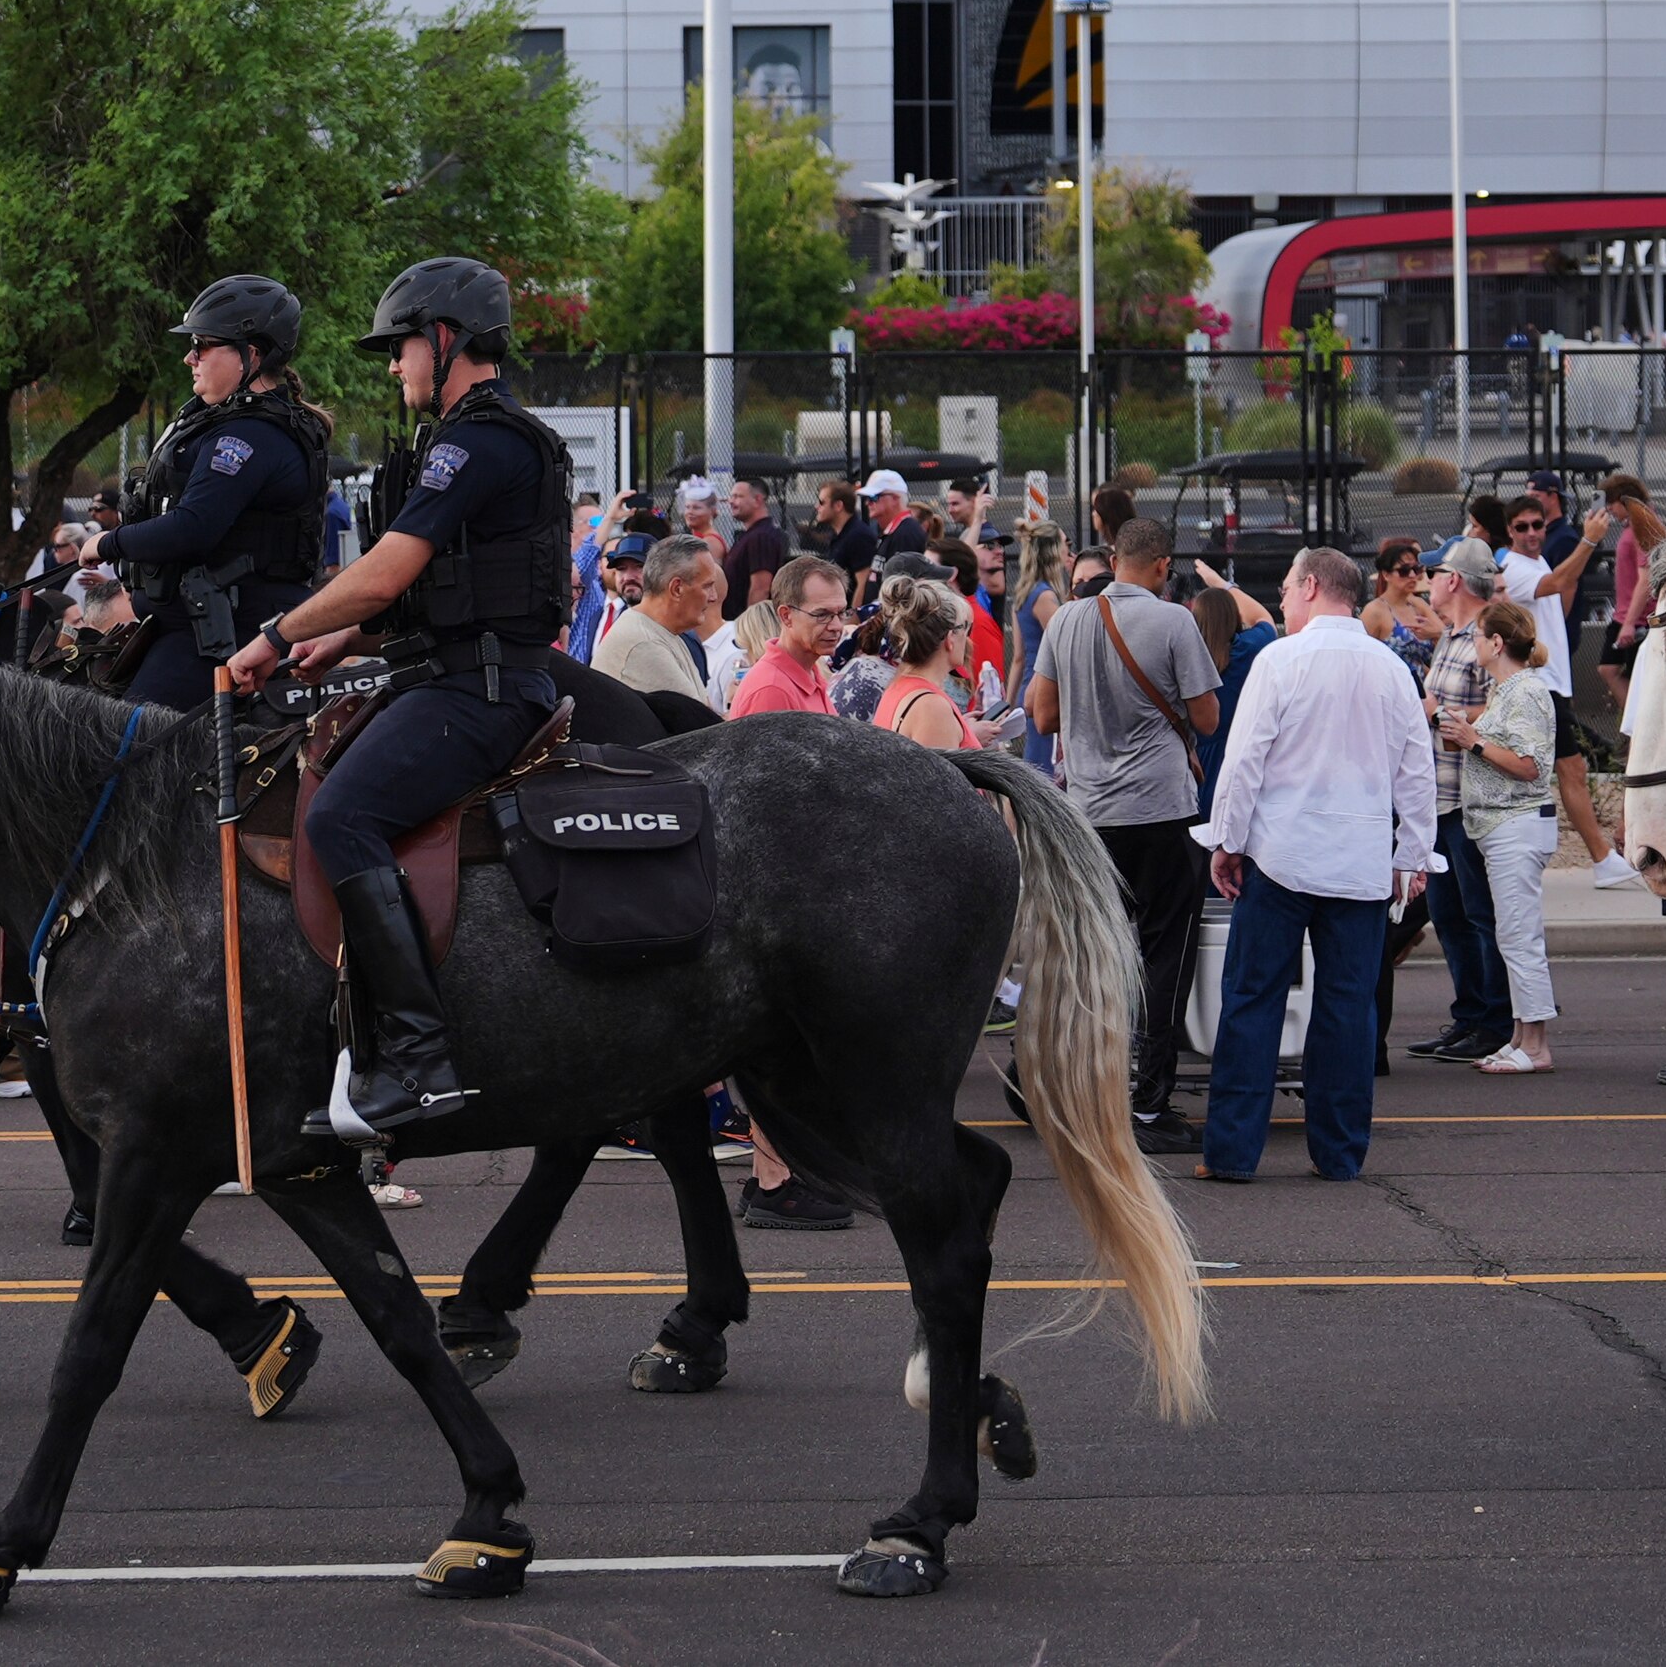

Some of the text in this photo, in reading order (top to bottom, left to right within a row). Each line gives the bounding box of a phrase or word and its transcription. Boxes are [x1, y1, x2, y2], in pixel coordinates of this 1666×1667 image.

[221, 437, 251, 452] POLICE
[434, 445, 467, 460] POLICE
[286, 674, 392, 705] POLICE
[553, 813, 681, 834] POLICE
